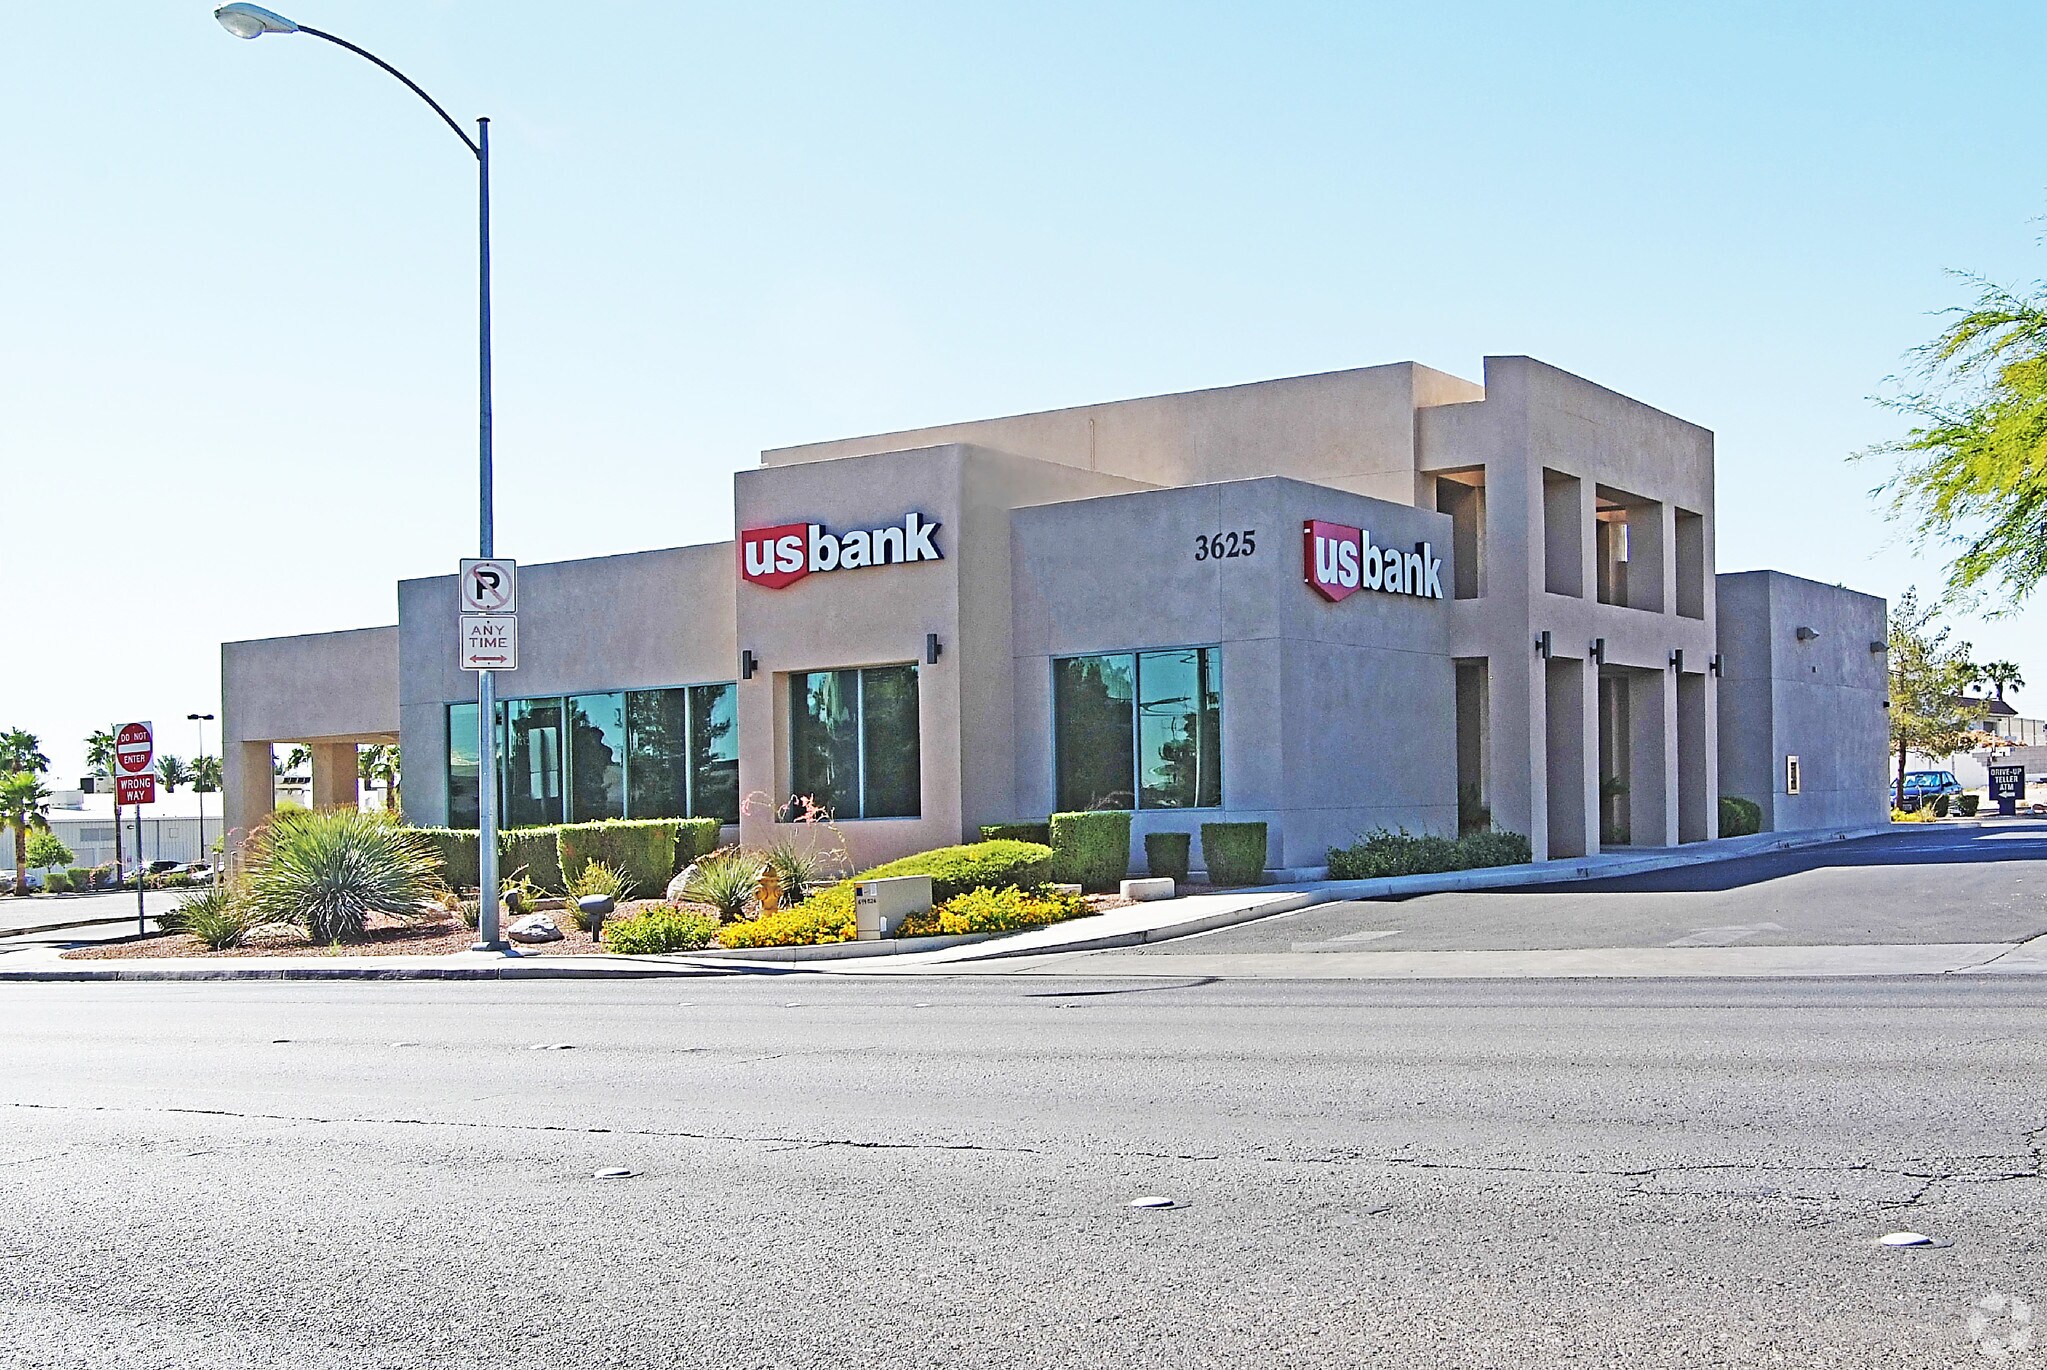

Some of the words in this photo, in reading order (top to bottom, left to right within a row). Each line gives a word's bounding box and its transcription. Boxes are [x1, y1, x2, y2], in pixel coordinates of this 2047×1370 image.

[1195, 530, 1256, 561] 3625
[471, 625, 505, 636] ANY
[469, 637, 508, 648] TIME
[121, 733, 130, 742] DO
[133, 731, 147, 741] NOT
[124, 754, 146, 765] ENTER
[1990, 768, 2022, 776] DRIVE-UP
[121, 778, 151, 790] WRONG
[1995, 776, 2019, 784] TELLER
[2000, 783, 2015, 791] ATM
[126, 790, 145, 801] WAY
